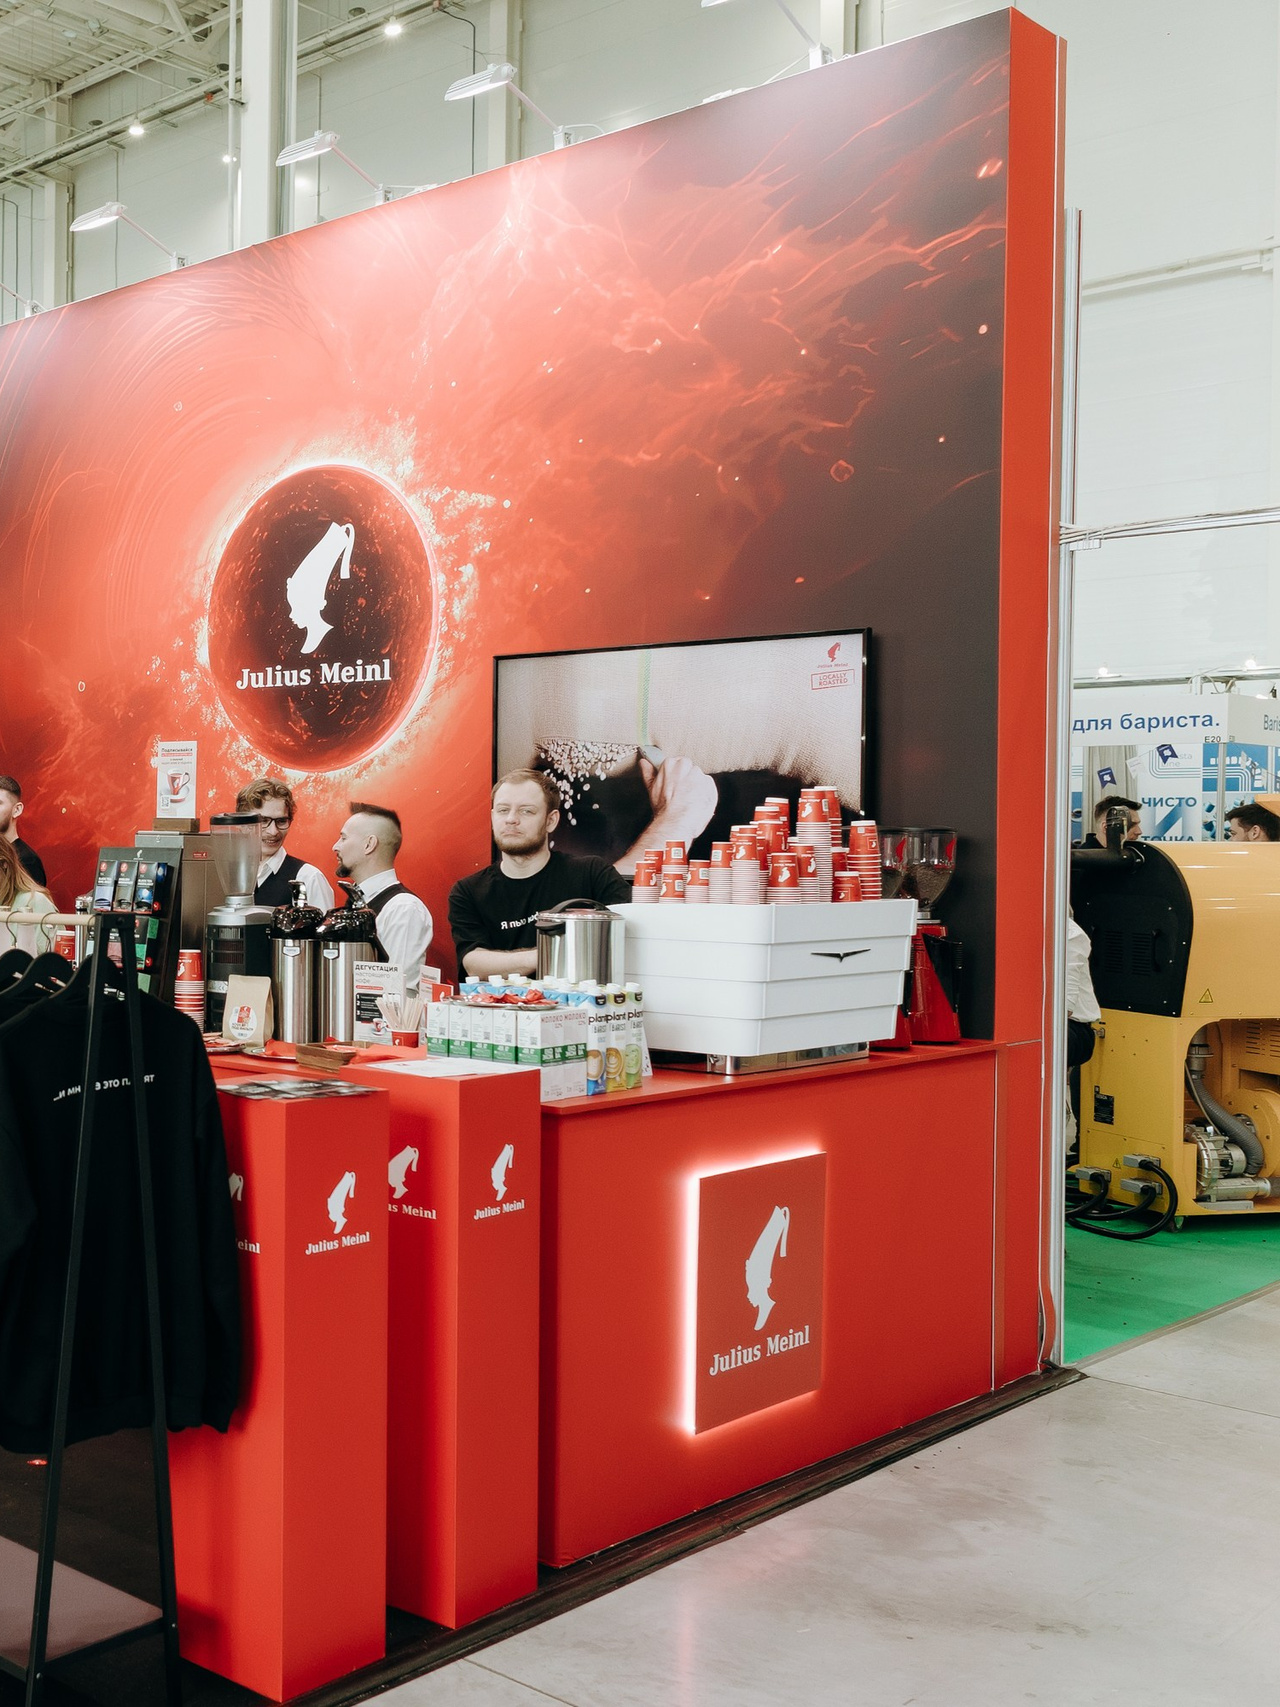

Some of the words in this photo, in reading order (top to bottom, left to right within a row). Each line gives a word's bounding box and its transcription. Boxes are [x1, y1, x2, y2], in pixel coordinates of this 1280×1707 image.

[235, 665, 312, 690] Julius
[319, 659, 392, 687] Meinl
[818, 677, 849, 686] ROASTED
[819, 672, 847, 681] LOCALLY
[1072, 717, 1112, 734] для
[1120, 713, 1220, 733] бариста.
[1204, 735, 1221, 743] E20
[1141, 796, 1197, 808] ЧИСТО
[500, 921, 508, 930] Я
[509, 918, 527, 928] пью
[355, 964, 398, 972] ДЕГУСТАЦИЯ
[67, 1085, 82, 1096] мн
[103, 1079, 120, 1090] это
[121, 1074, 155, 1086] пят
[402, 1204, 437, 1220] Meinl
[473, 1205, 501, 1220] Julius
[502, 1199, 525, 1214] Meinl
[235, 1240, 261, 1254] einl
[305, 1238, 339, 1255] Julius
[341, 1231, 370, 1247] Meinl
[709, 1343, 761, 1377] Julius
[766, 1325, 810, 1357] Meinl
